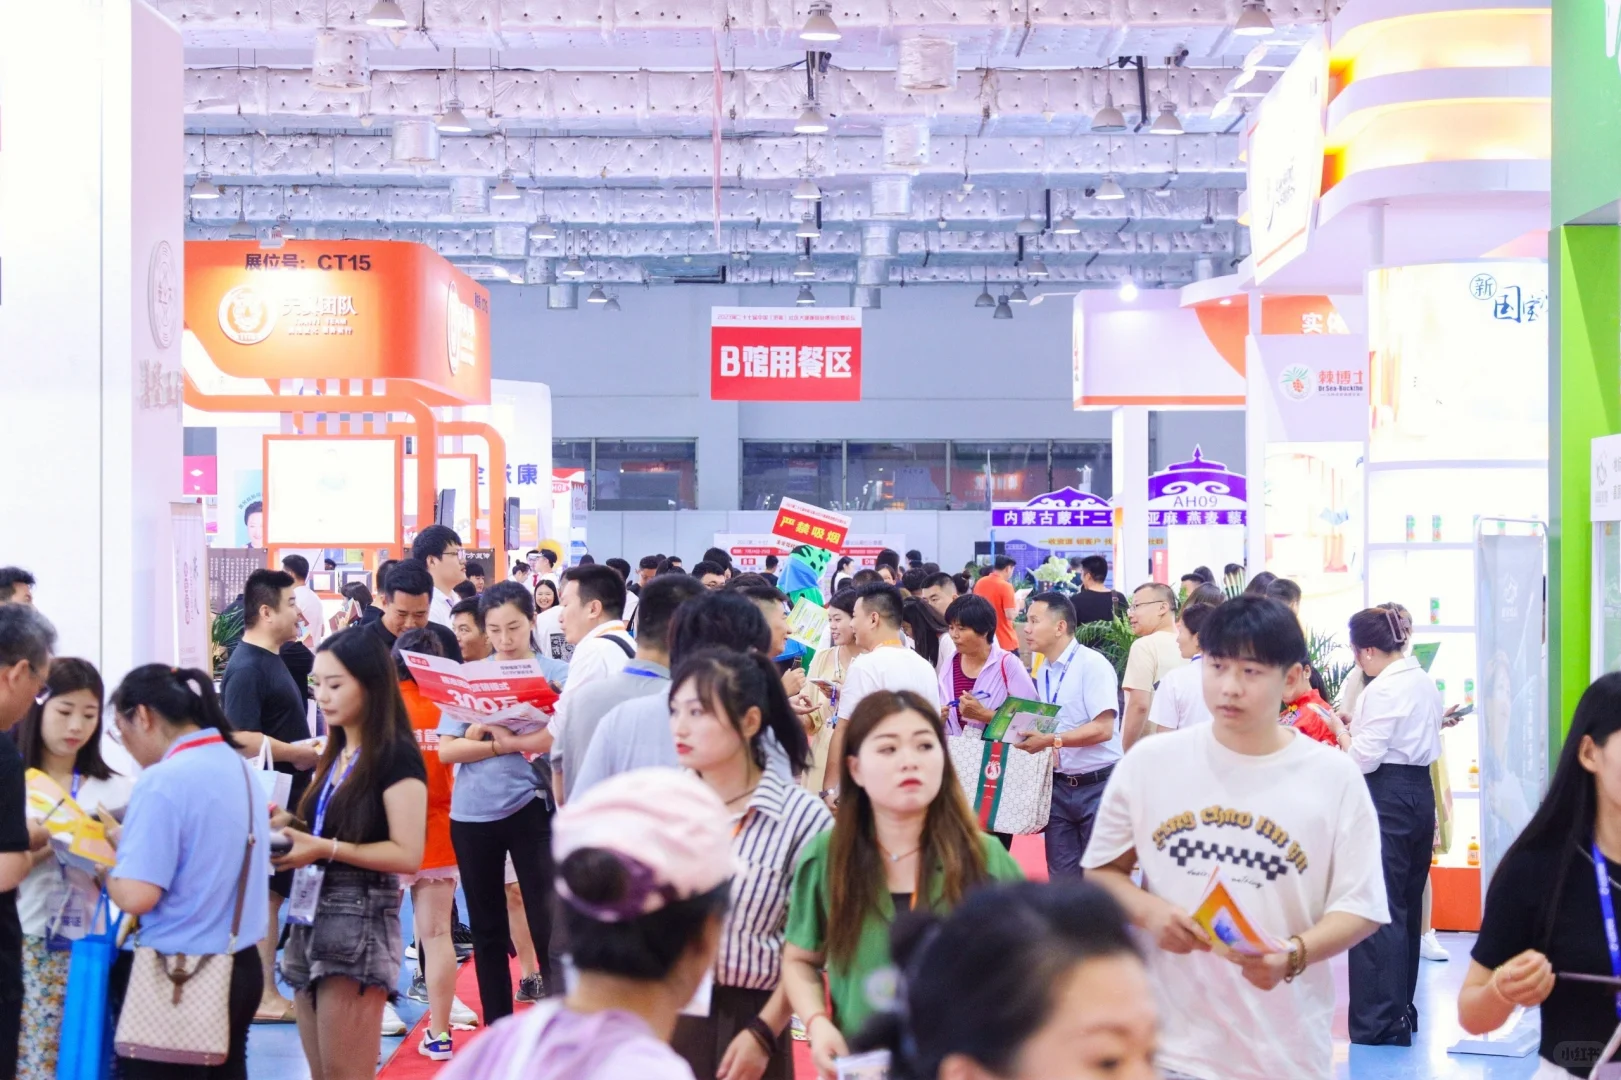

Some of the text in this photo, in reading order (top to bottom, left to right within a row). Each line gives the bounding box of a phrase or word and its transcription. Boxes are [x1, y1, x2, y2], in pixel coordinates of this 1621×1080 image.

[318, 254, 371, 270] CT15
[720, 345, 852, 378] B馆用餐区
[1173, 496, 1218, 508] AH09
[1004, 510, 1113, 526] 内蒙古蒙十二
[779, 516, 841, 545] 严禁吸烟
